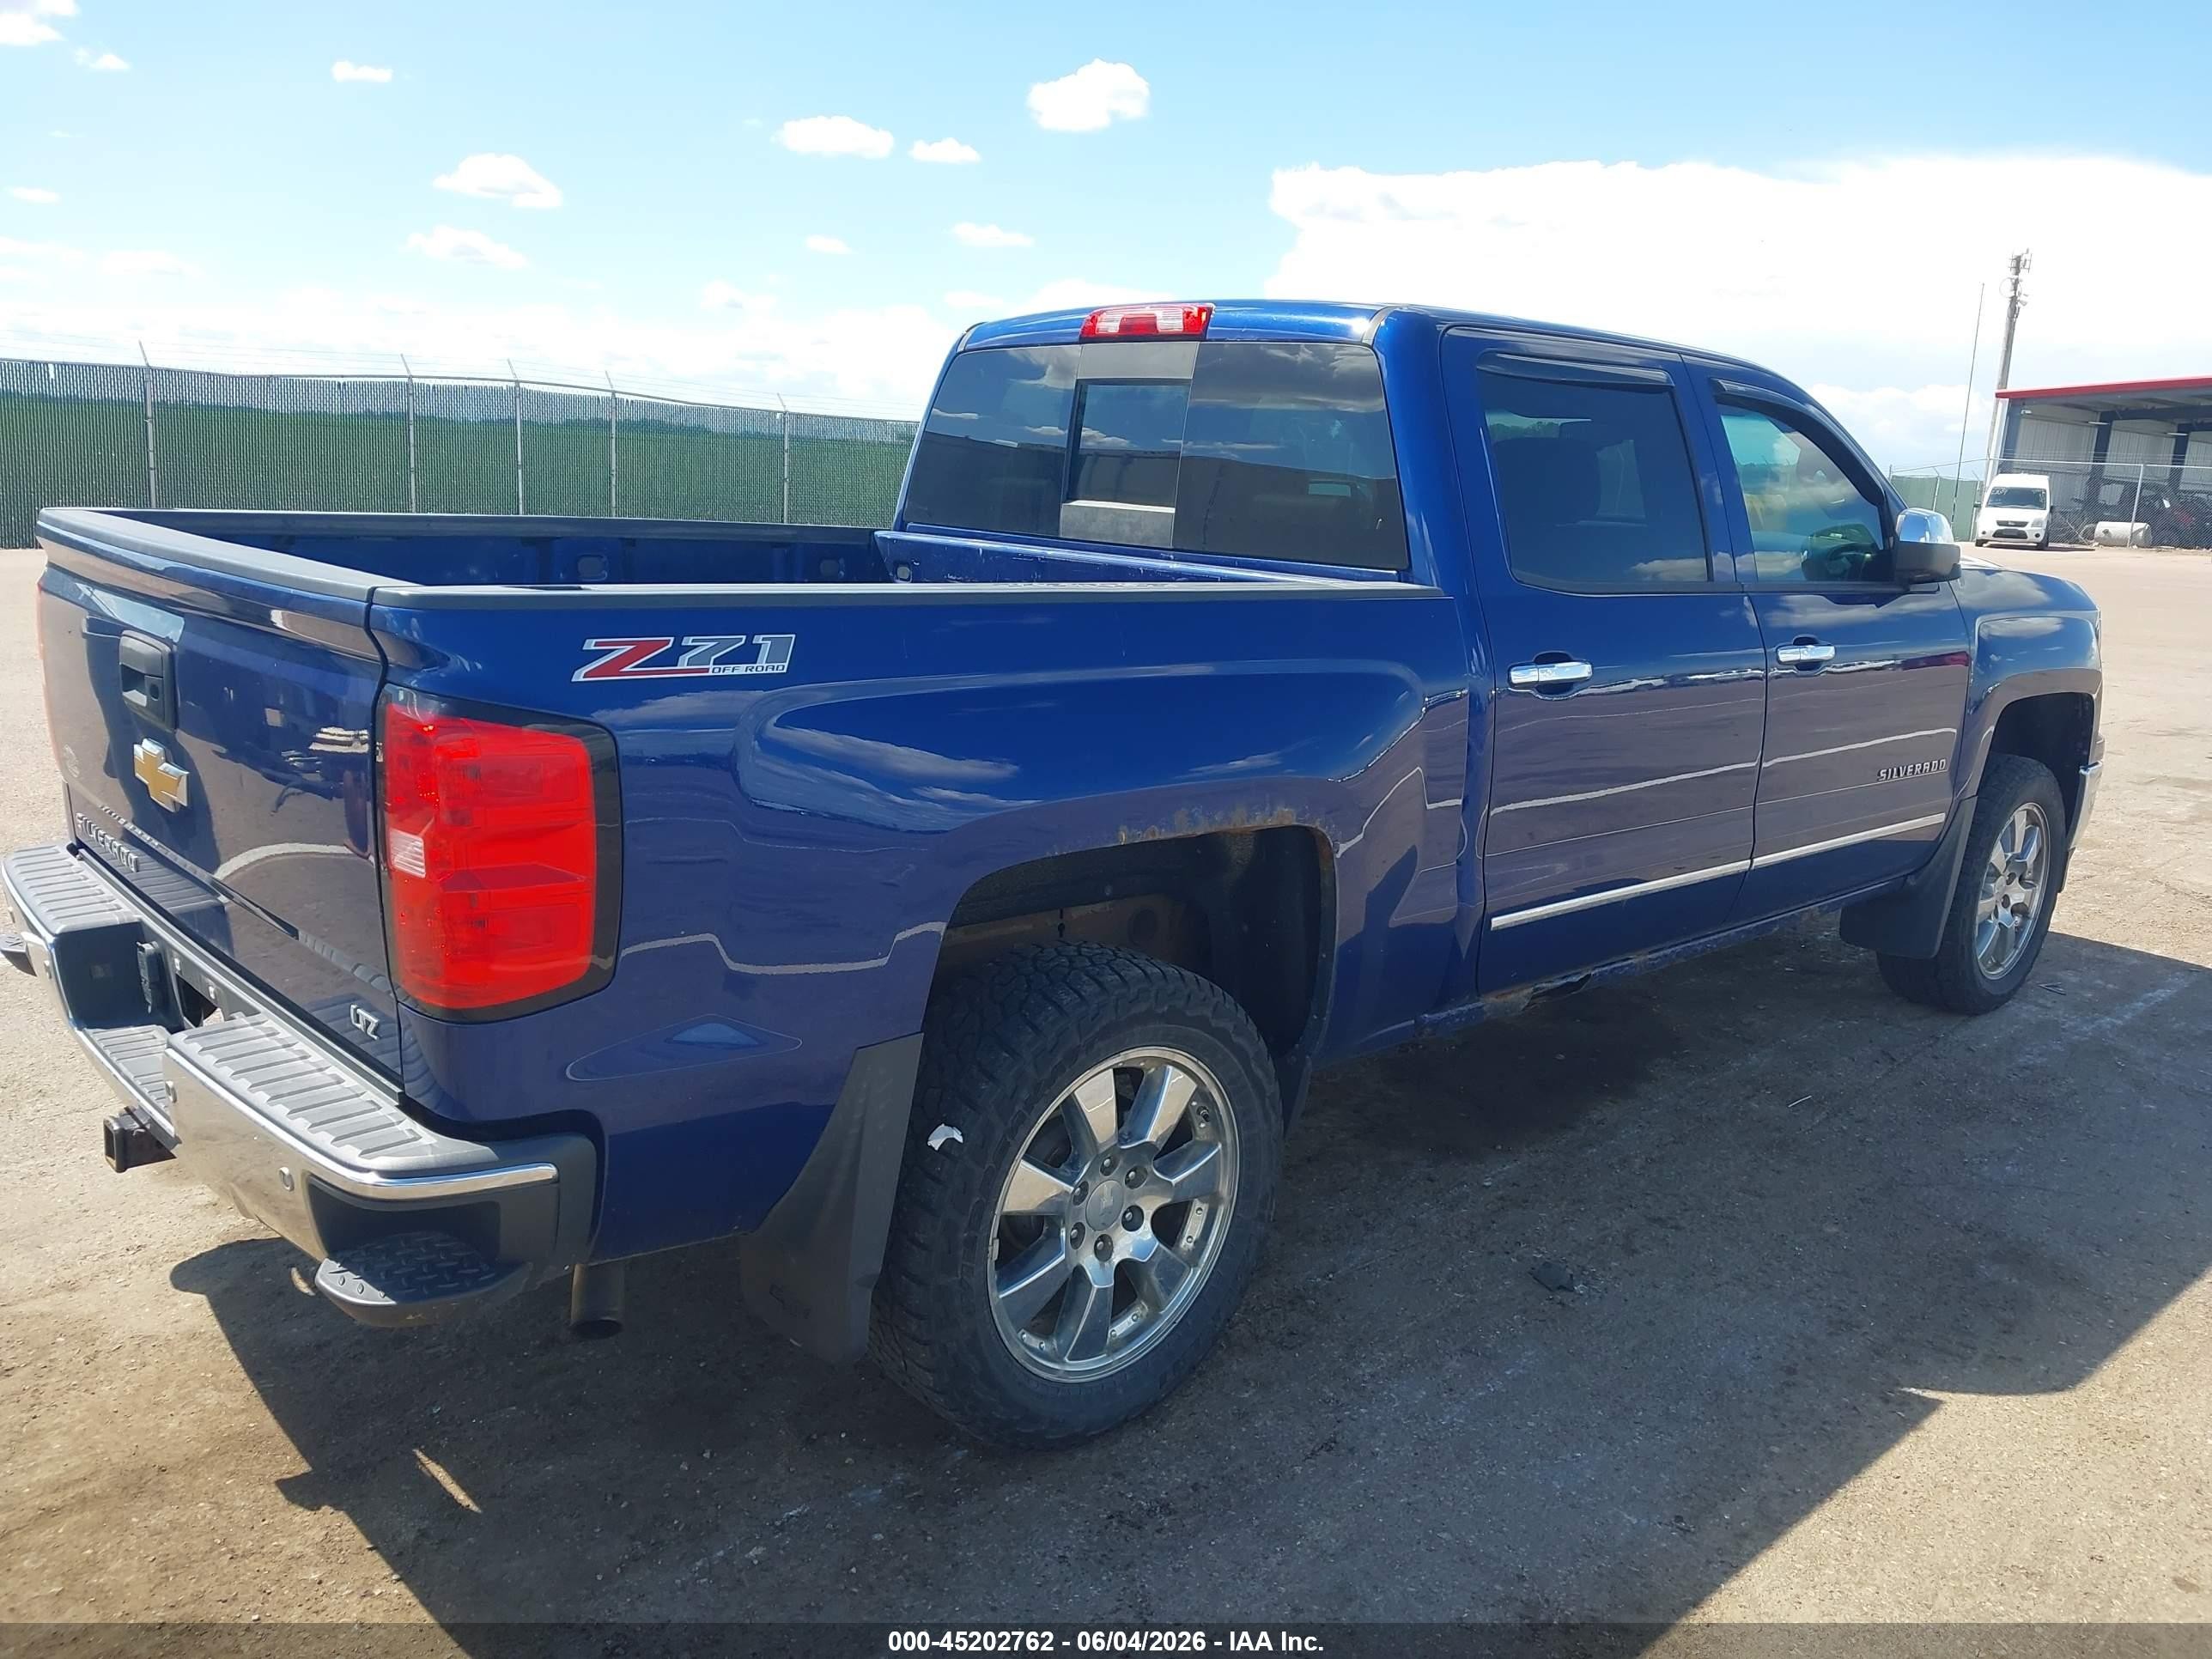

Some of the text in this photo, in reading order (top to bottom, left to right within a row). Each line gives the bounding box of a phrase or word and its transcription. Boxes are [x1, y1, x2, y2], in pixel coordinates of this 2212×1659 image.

[571, 634, 796, 682] Z71
[712, 664, 787, 674] OFF ROAD
[1878, 758, 1947, 781] SILVERADO
